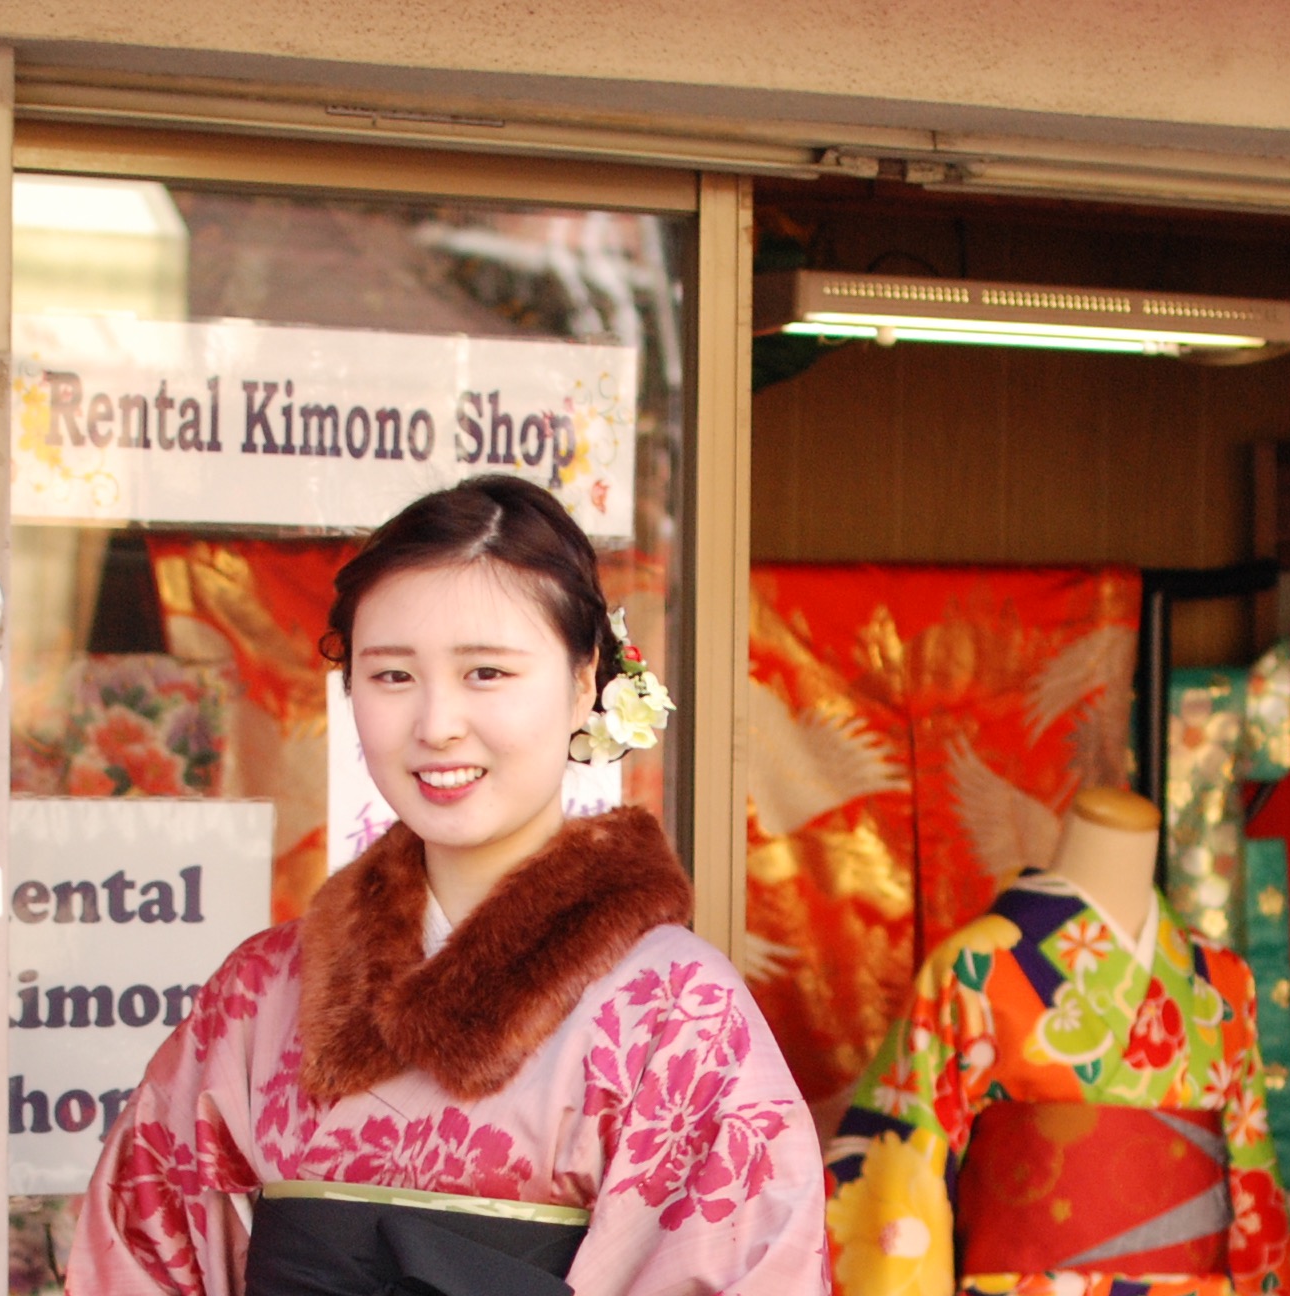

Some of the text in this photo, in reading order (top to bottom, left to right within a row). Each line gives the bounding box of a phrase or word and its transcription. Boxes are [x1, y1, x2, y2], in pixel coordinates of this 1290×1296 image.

[43, 370, 578, 489] Rental Kimono Shop
[9, 864, 206, 925] ental
